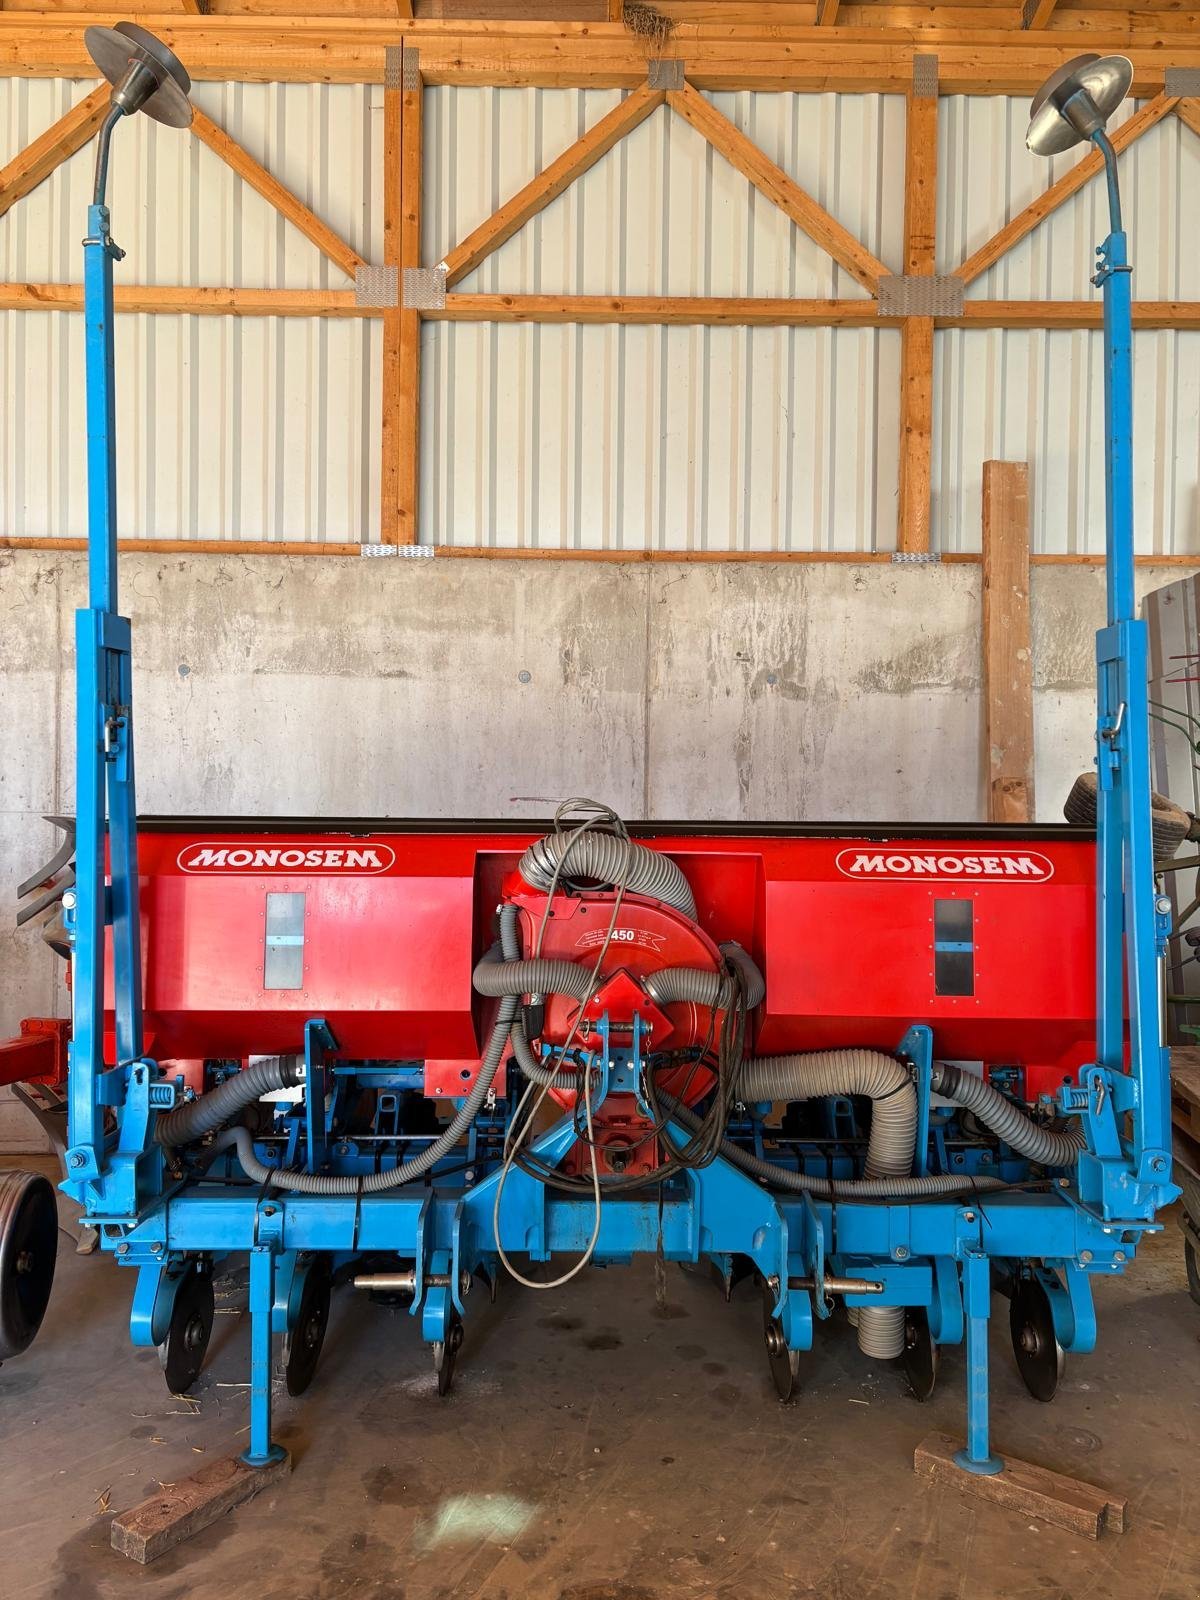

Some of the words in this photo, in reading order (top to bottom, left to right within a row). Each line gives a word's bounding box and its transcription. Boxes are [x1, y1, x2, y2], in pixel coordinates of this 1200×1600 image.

[187, 849, 383, 867] MONOSEM
[850, 855, 1044, 875] MONOSEM
[611, 930, 635, 941] 450
